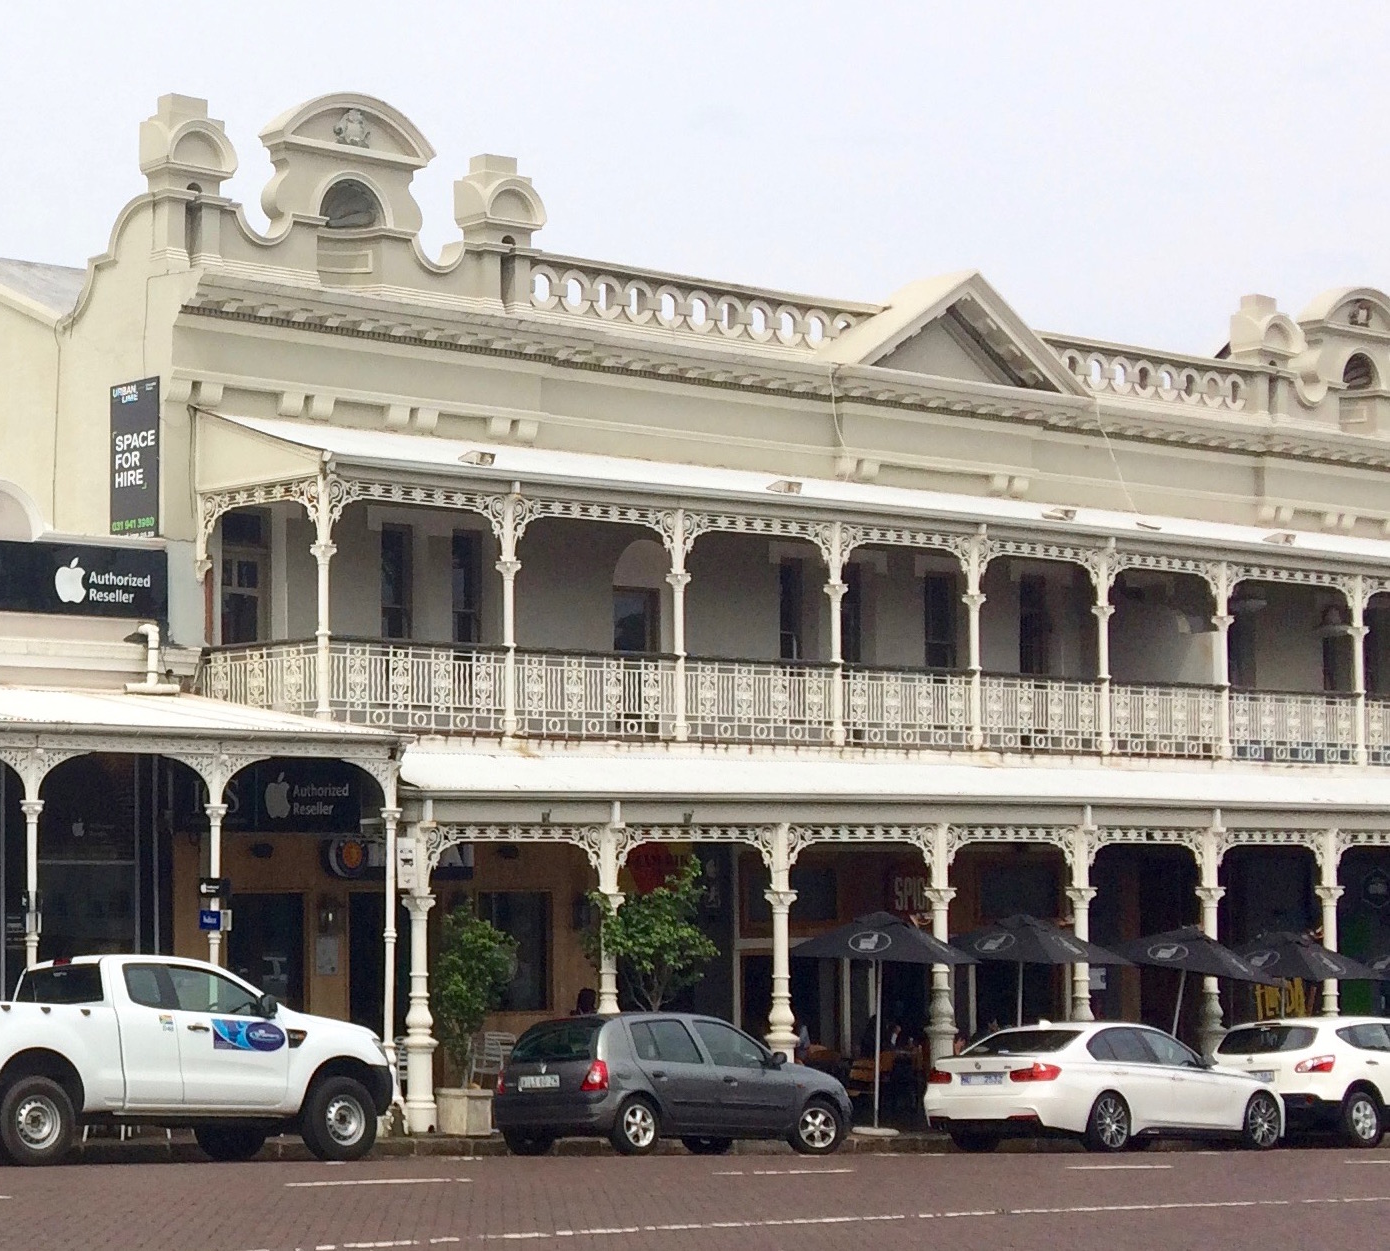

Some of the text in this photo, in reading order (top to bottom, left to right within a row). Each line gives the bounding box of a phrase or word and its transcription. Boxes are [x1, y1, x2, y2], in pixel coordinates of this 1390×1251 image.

[115, 429, 156, 452] SPACE
[115, 450, 141, 470] FOR
[115, 468, 144, 489] HIRE
[88, 571, 151, 588] Authorized
[89, 588, 135, 604] Reseller
[292, 783, 350, 798] Authorized
[293, 802, 335, 816] Reseller
